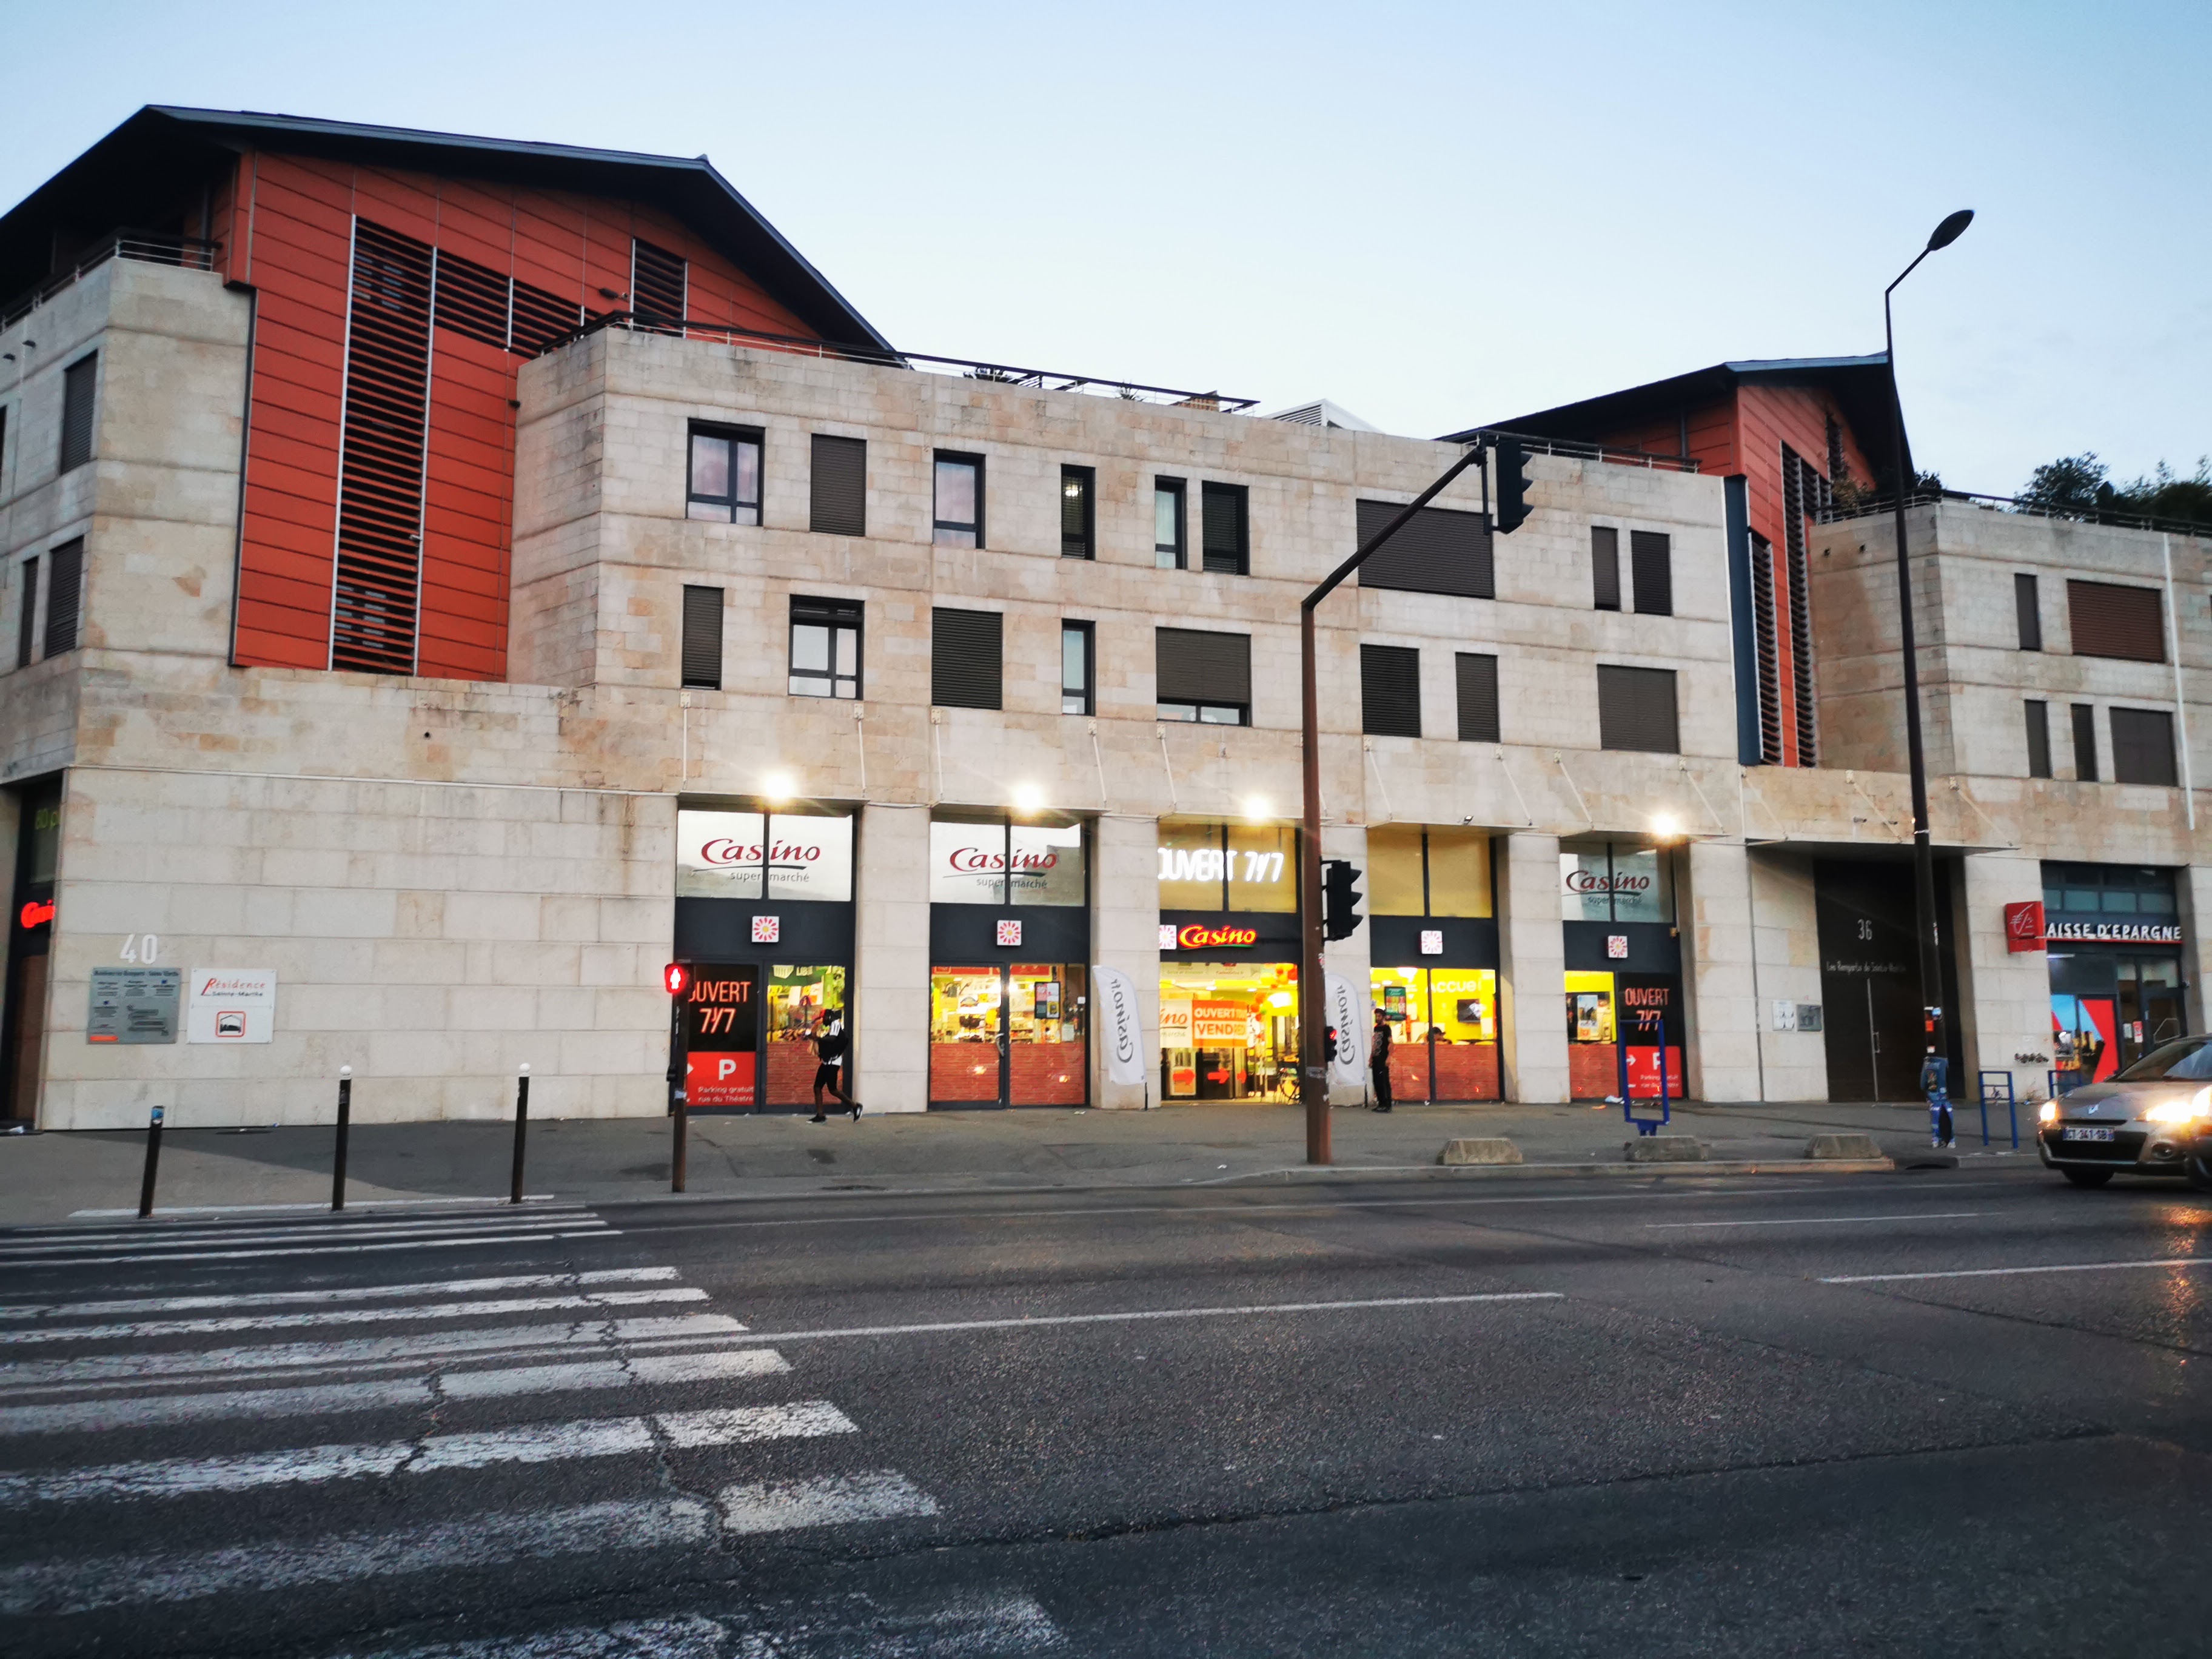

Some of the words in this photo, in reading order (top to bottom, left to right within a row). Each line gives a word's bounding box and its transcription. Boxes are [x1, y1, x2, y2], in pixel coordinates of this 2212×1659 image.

[701, 839, 820, 864] Casino
[950, 847, 1058, 872] Casino
[1566, 870, 1650, 892] Casino
[1178, 924, 1257, 948] Casino
[1857, 919, 1872, 940] 36
[2046, 922, 2092, 939] AISSE
[119, 933, 158, 965] 40
[1624, 988, 1669, 1006] OUVERT
[1160, 1008, 1188, 1025] ino
[719, 1059, 737, 1081] P
